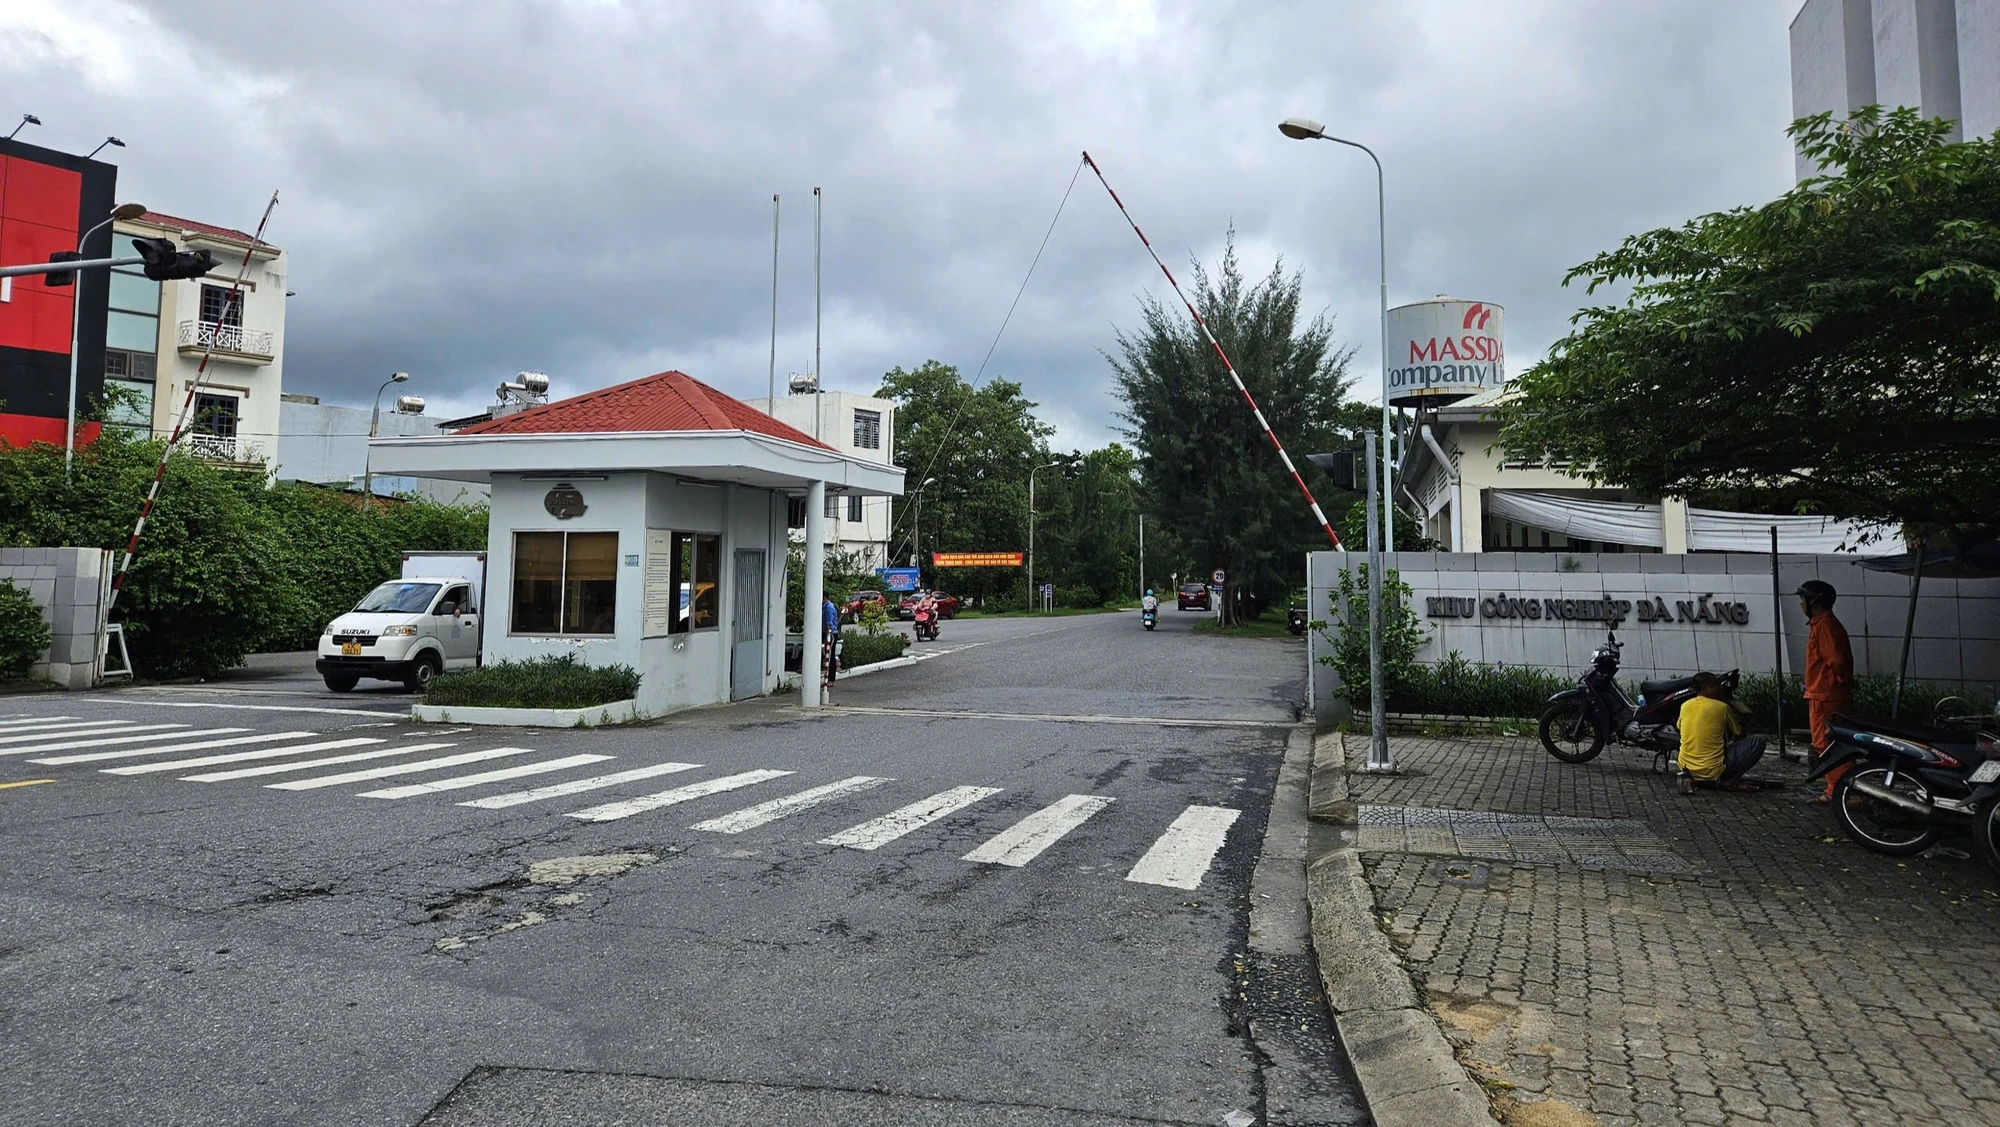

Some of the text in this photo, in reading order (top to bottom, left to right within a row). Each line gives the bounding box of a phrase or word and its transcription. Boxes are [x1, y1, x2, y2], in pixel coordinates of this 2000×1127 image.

[1410, 336, 1504, 365] MASSDA
[1388, 364, 1487, 388] ompany
[1426, 596, 1476, 619] KHU
[1481, 592, 1542, 620] CÔNG
[1544, 593, 1632, 622] NGHIỆP
[1636, 595, 1674, 622] ĐÀ
